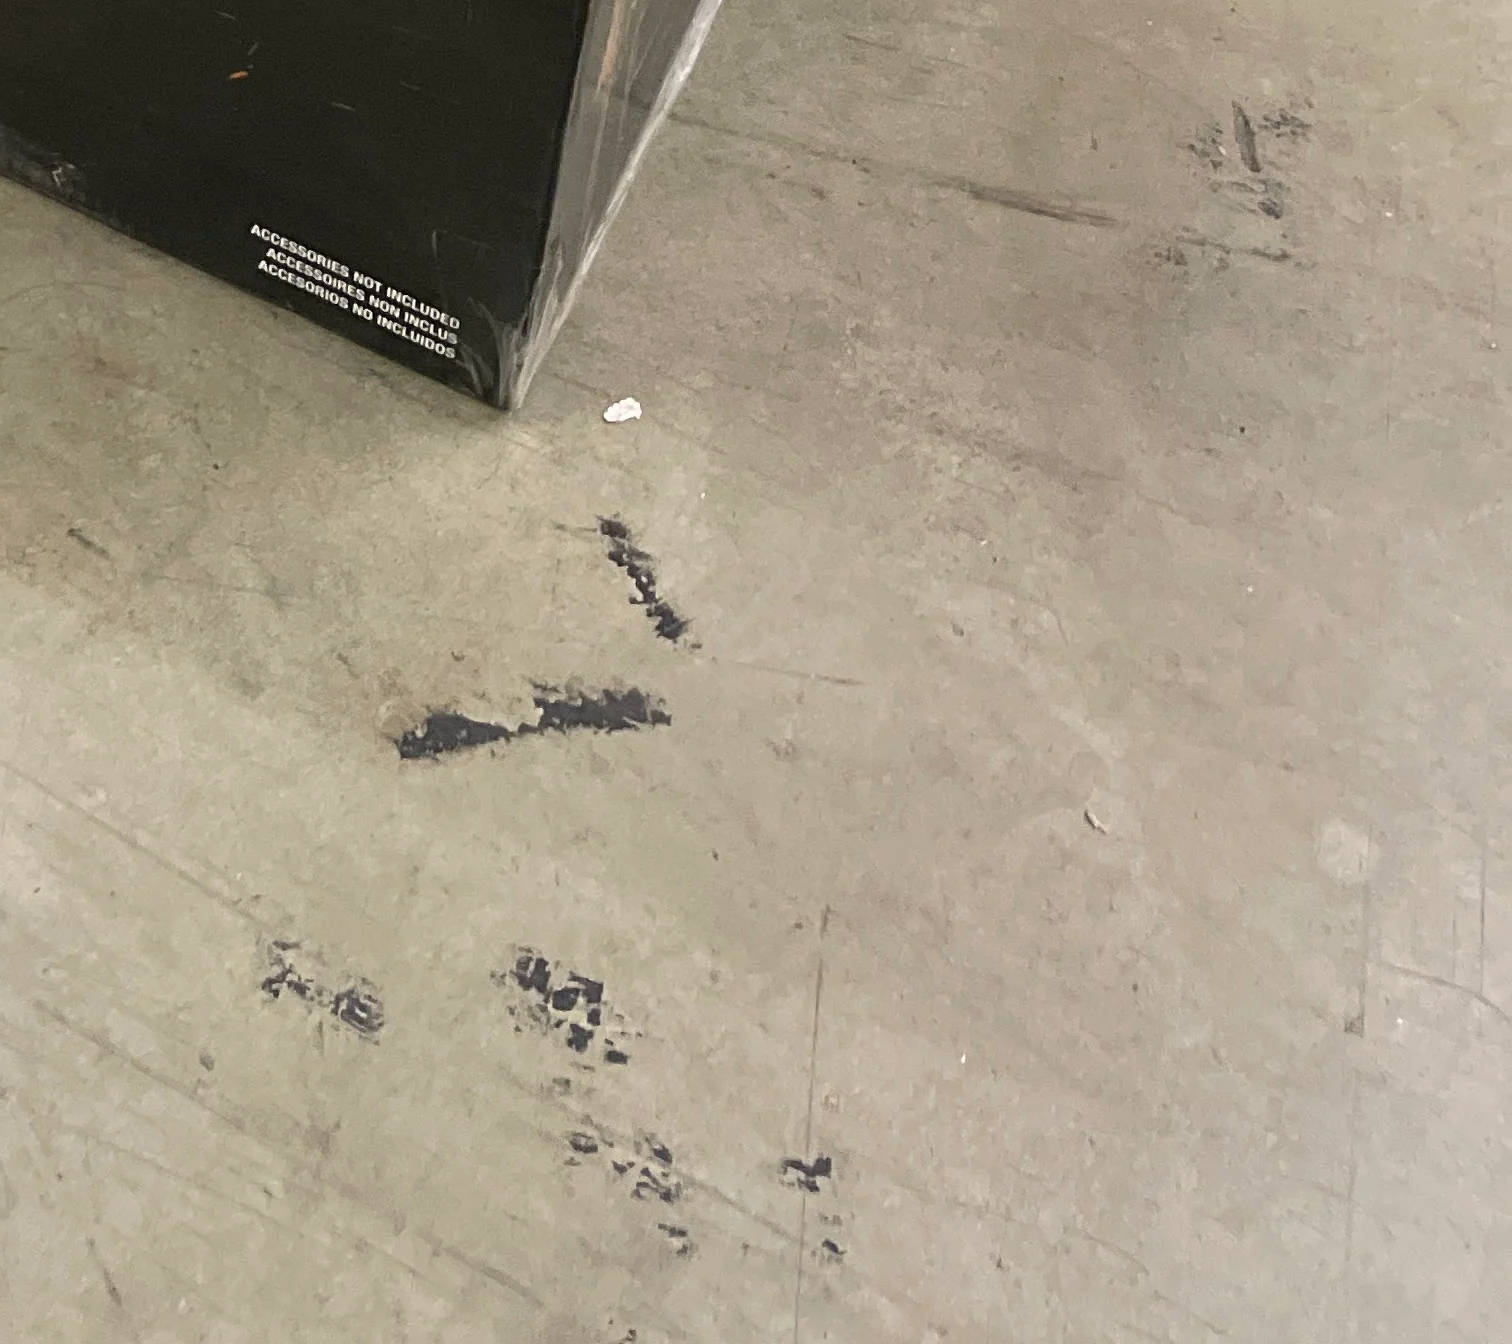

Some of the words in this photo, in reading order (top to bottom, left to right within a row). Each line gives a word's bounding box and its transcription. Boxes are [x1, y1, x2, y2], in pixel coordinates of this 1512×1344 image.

[251, 225, 349, 277] ACCESSORIES
[354, 272, 382, 292] NOT
[387, 287, 459, 328] INCLUDED
[258, 260, 348, 308] ACCESORIOS
[353, 303, 372, 320] NO
[377, 315, 454, 358] INCLUIDOS
[266, 248, 364, 300] ACCESSOIRES
[369, 295, 400, 317] NON
[405, 312, 457, 344] INCLUS
